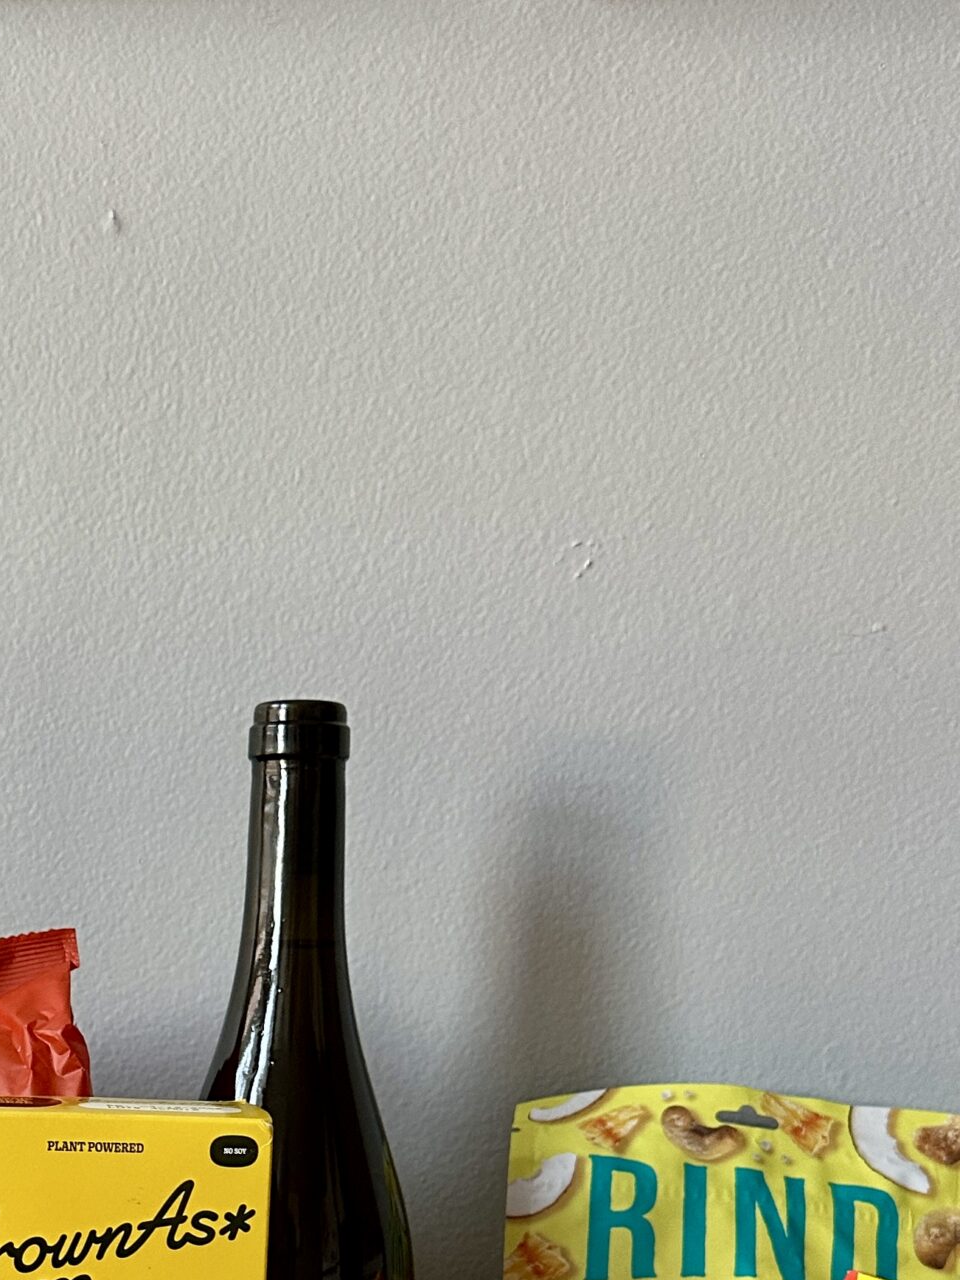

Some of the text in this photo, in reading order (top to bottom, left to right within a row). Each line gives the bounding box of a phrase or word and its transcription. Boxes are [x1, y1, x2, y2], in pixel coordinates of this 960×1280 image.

[47, 1140, 144, 1154] PLANT POWERED
[223, 1147, 247, 1155] NO SOY
